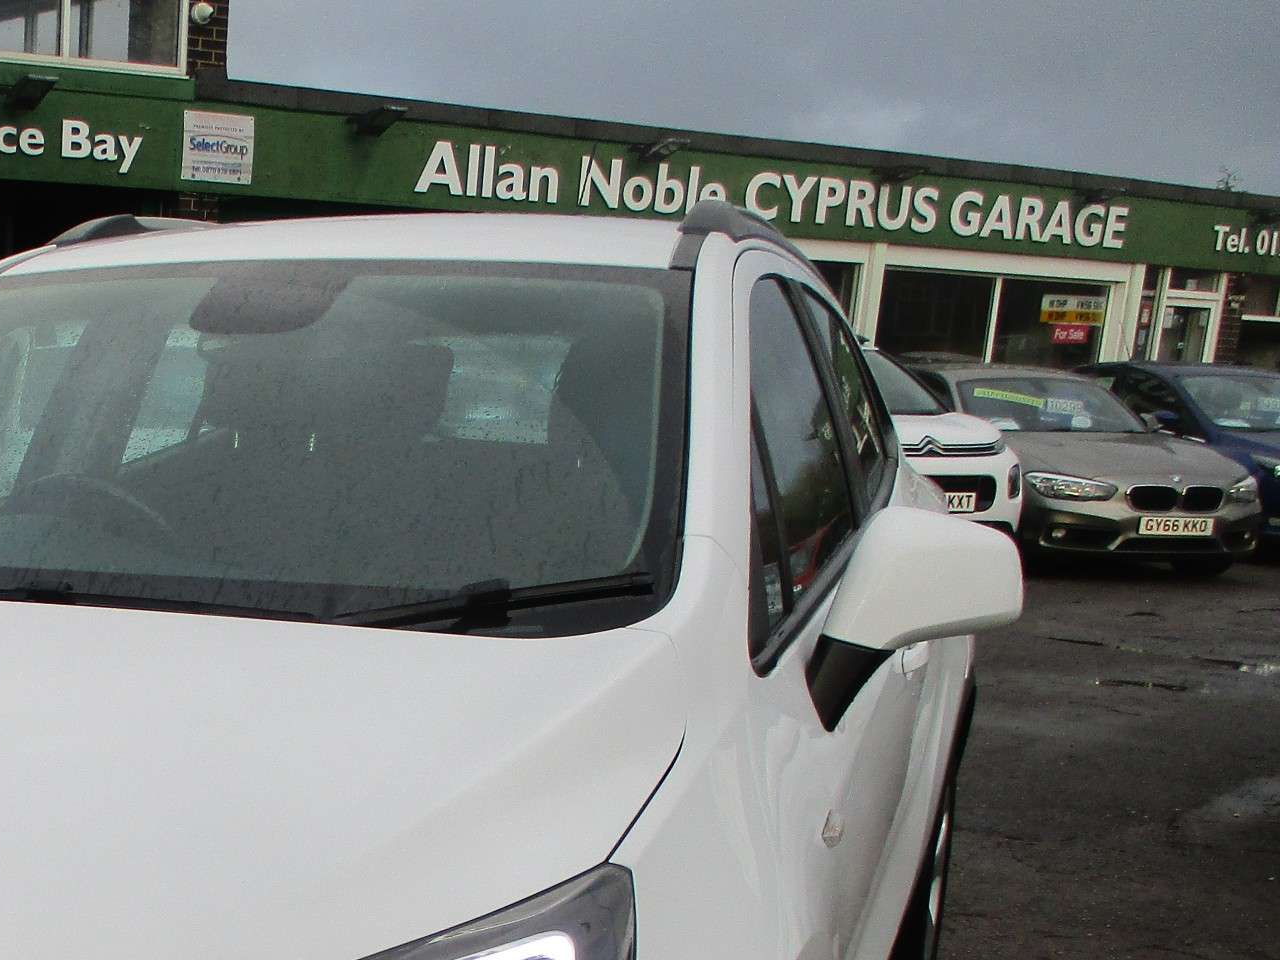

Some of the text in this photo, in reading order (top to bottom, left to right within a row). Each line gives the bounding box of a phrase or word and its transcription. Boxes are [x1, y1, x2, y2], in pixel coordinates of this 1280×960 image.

[61, 119, 144, 174] Bay
[414, 141, 1130, 249] Allan Noble CYPRUS GARAGE
[1214, 225, 1280, 256] Tel. 01
[1054, 328, 1084, 340] For Sale
[947, 494, 973, 509] KXT
[1145, 518, 1180, 532] GY66
